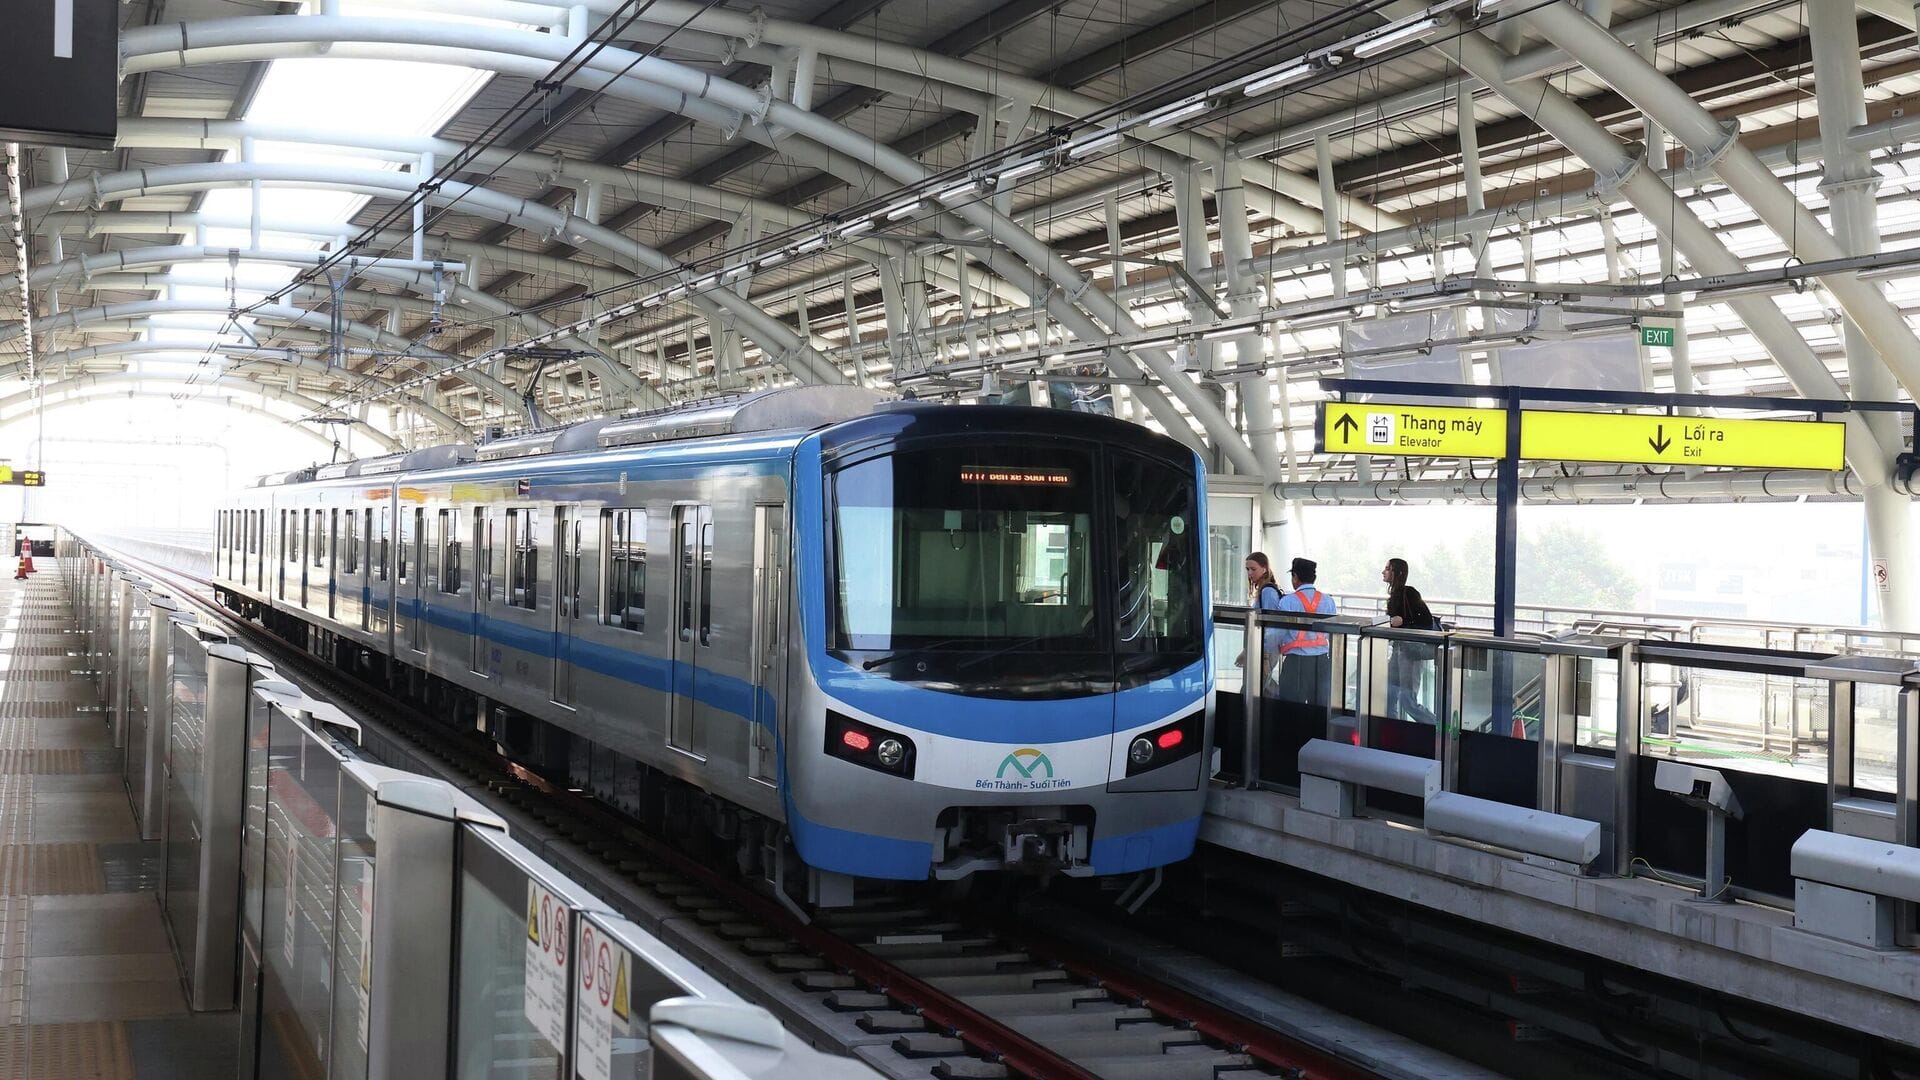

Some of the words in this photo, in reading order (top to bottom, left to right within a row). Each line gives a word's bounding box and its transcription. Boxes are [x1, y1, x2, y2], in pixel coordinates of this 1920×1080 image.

[1646, 329, 1669, 344] EXIT
[1401, 413, 1446, 435] Thang
[1451, 416, 1483, 436] máy
[1684, 423, 1705, 441] Lối
[1709, 429, 1724, 442] ra
[1399, 435, 1442, 448] Elevator
[1683, 445, 1702, 457] Exit
[975, 779, 993, 789] Bến
[995, 779, 1022, 790] Thành
[1030, 779, 1050, 789] Suối
[1053, 778, 1071, 788] Tiên
